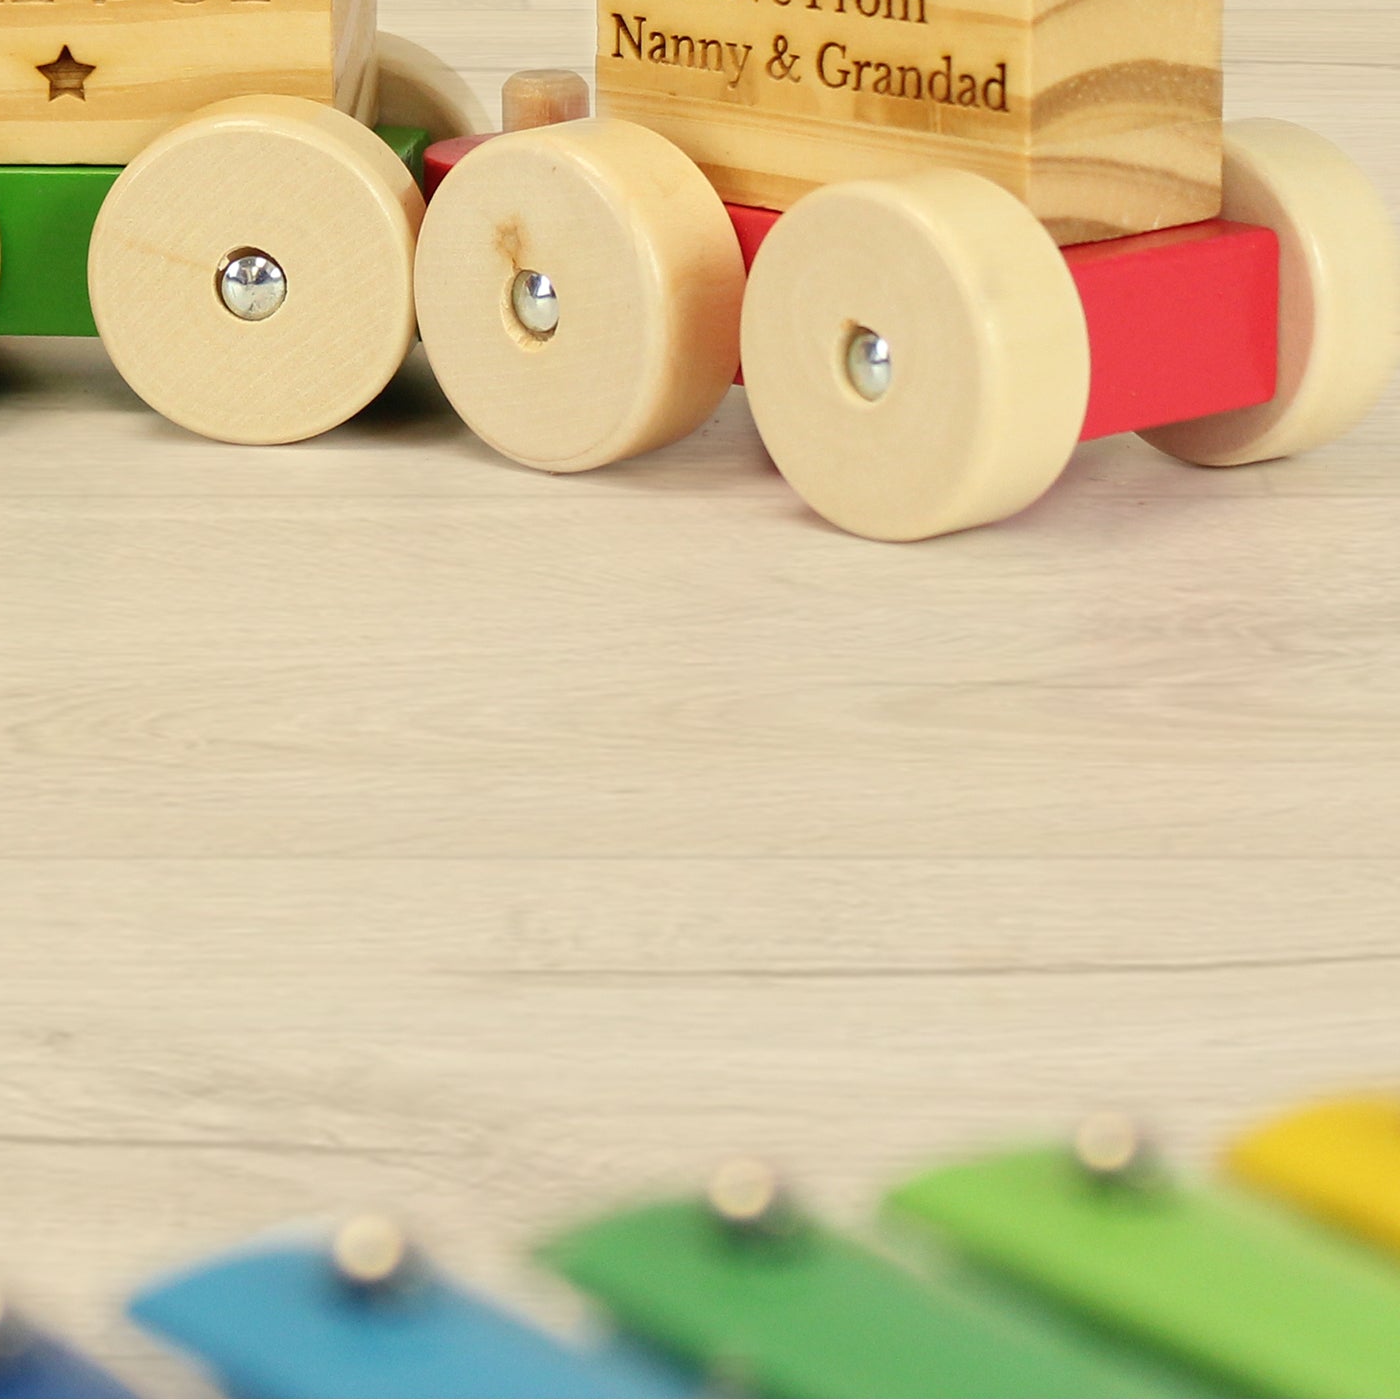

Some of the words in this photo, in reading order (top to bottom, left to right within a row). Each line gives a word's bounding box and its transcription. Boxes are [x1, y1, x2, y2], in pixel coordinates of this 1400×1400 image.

[611, 12, 752, 88] Nanny
[765, 34, 801, 83] &
[816, 41, 1010, 112] Grandad
